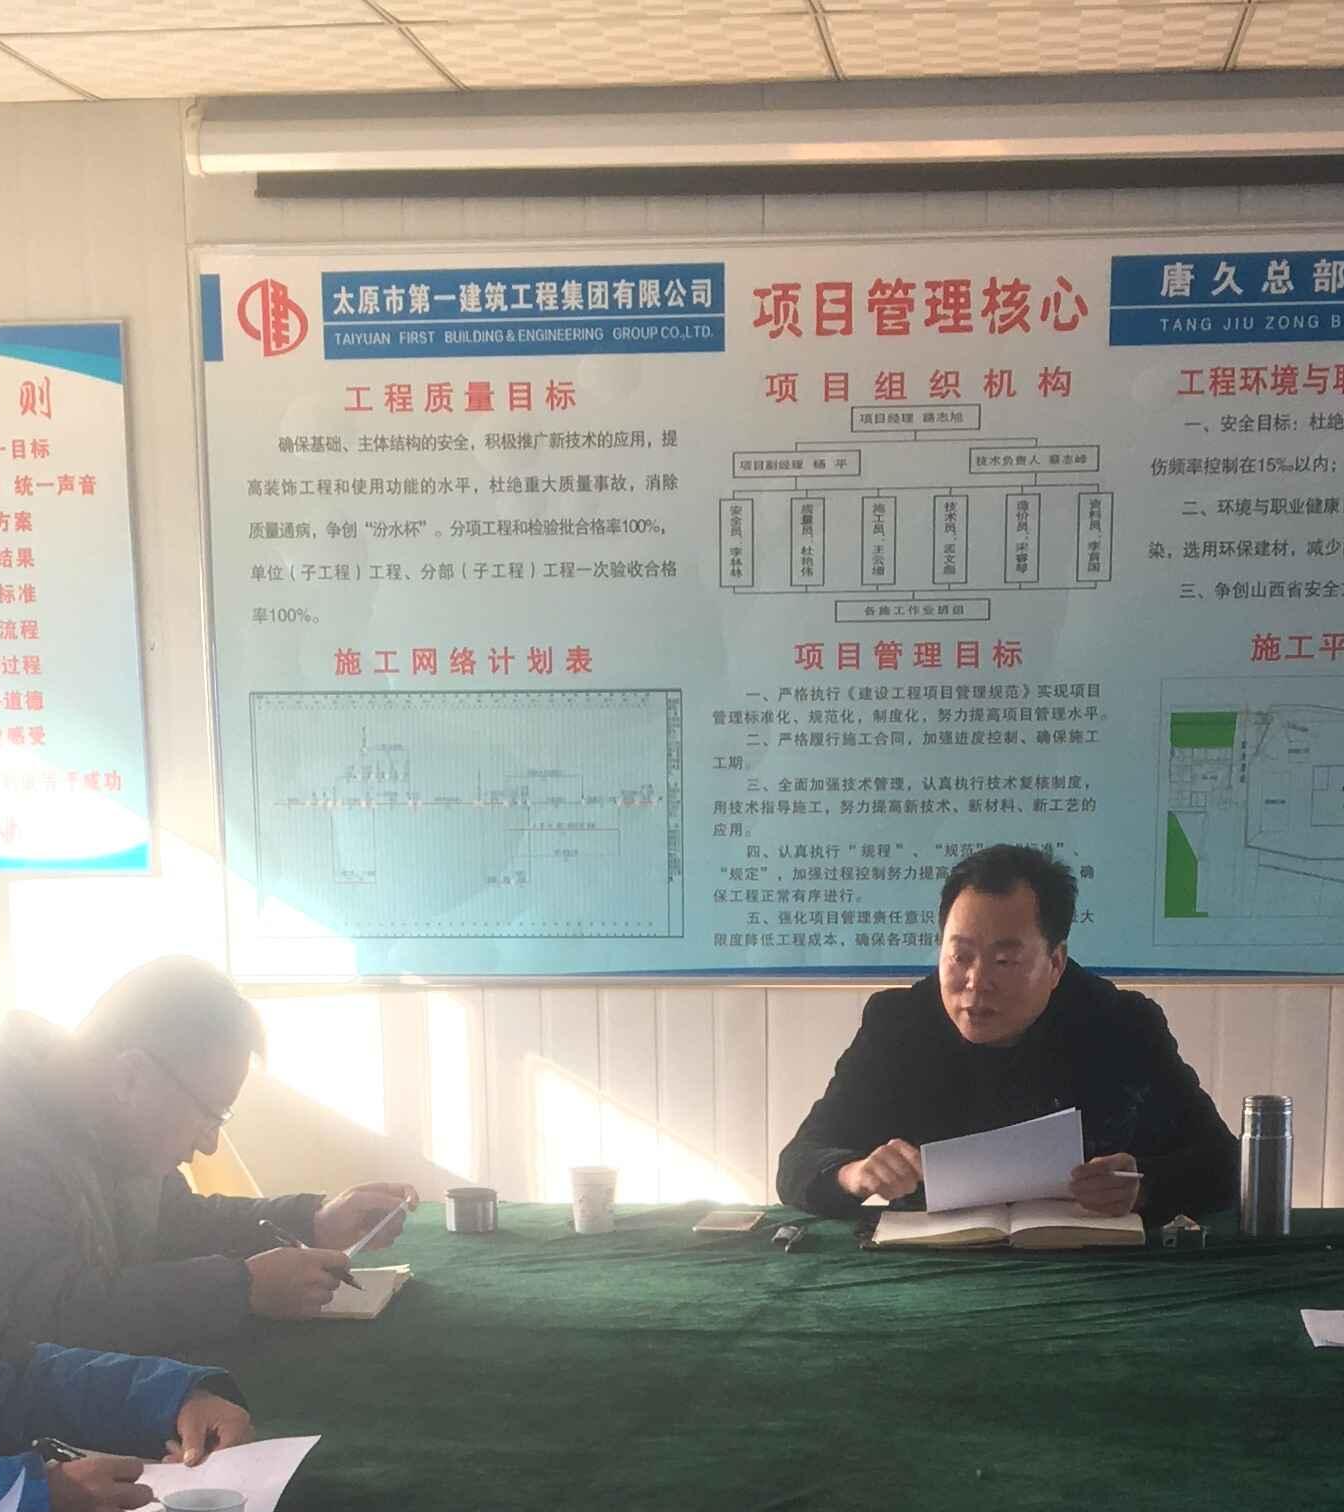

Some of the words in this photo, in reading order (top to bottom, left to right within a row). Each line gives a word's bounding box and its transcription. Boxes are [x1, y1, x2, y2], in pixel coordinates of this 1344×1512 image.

[333, 278, 713, 315] 太原市第一建筑工程集团有限公司
[753, 275, 1088, 340] 项目管理核心
[335, 331, 391, 346] TAIYUAN
[399, 330, 435, 345] FIRST
[612, 326, 657, 341] GROUP
[1159, 317, 1213, 332] TANG
[1223, 316, 1255, 331] JIU
[1264, 314, 1320, 330] ZONG
[344, 379, 577, 413] 工程质量目标
[765, 366, 1073, 402] 项目组织机构
[14, 474, 97, 497] 统一声音
[334, 645, 593, 676] 施工网络计划表
[793, 640, 1024, 670] 项目管理目标
